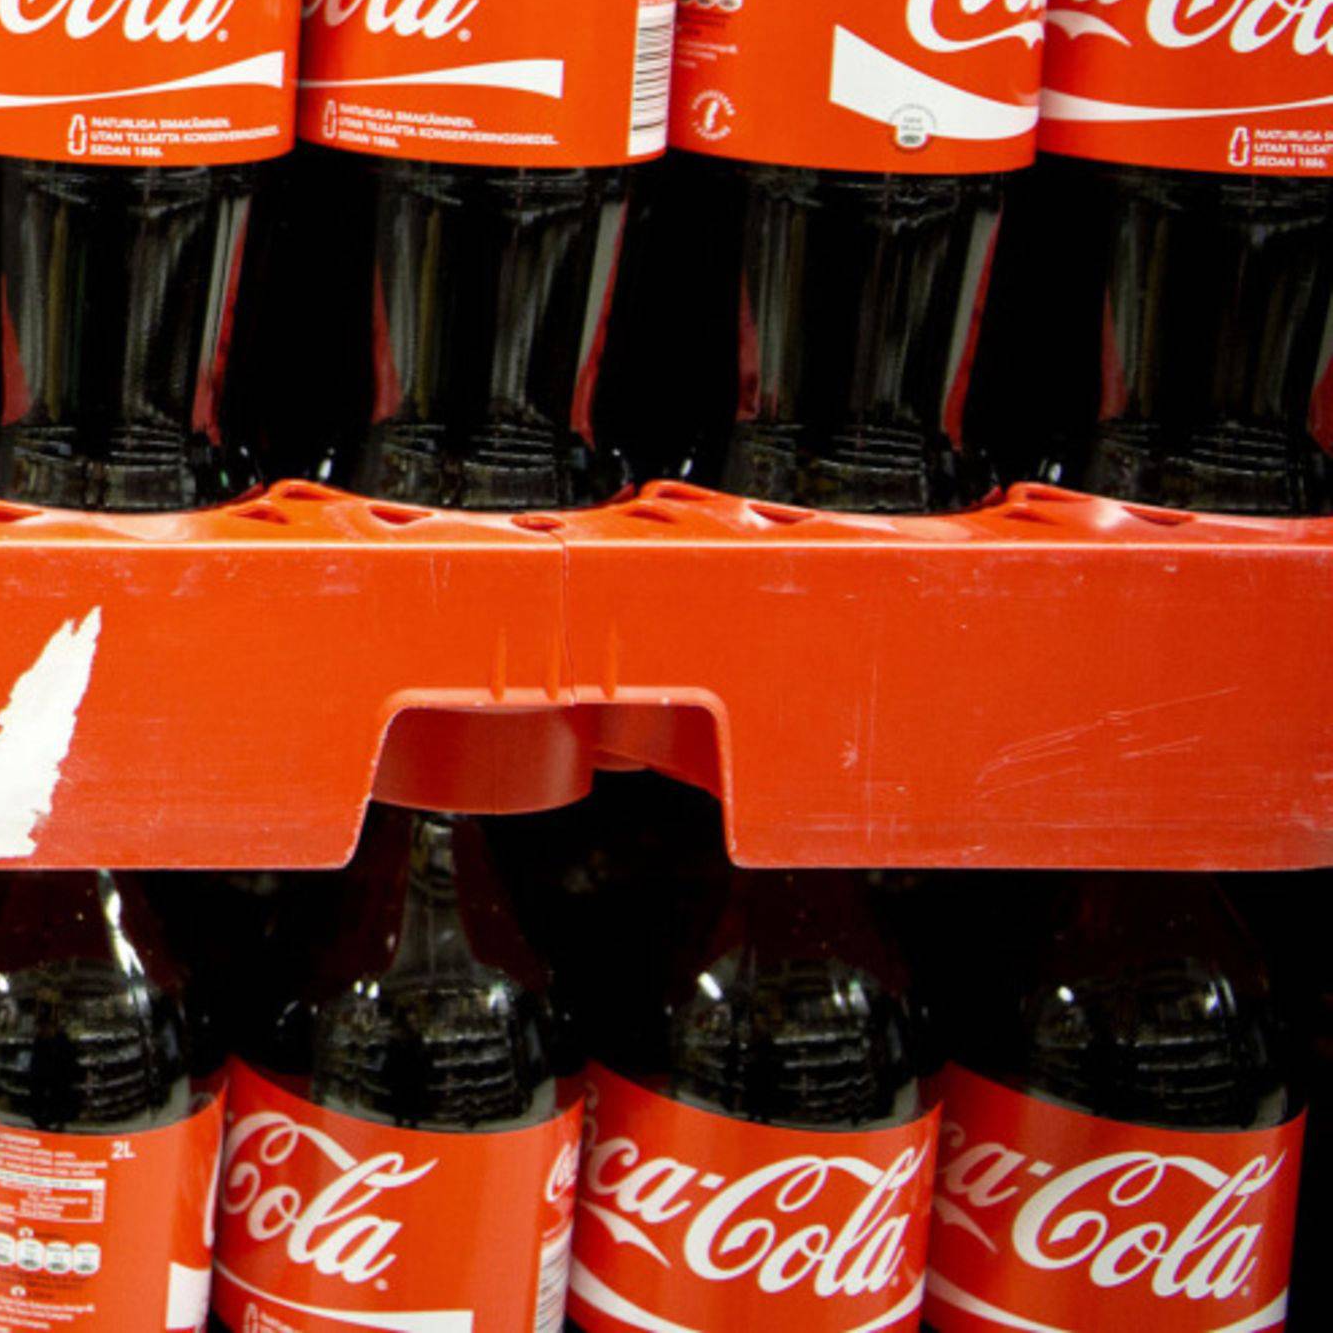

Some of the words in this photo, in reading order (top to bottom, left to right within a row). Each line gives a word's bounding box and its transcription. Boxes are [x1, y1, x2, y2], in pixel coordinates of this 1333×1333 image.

[91, 117, 157, 129] NATURLIGA
[91, 131, 123, 142] UTAN
[91, 144, 131, 156] SEDAN
[110, 1140, 136, 1160] 2L
